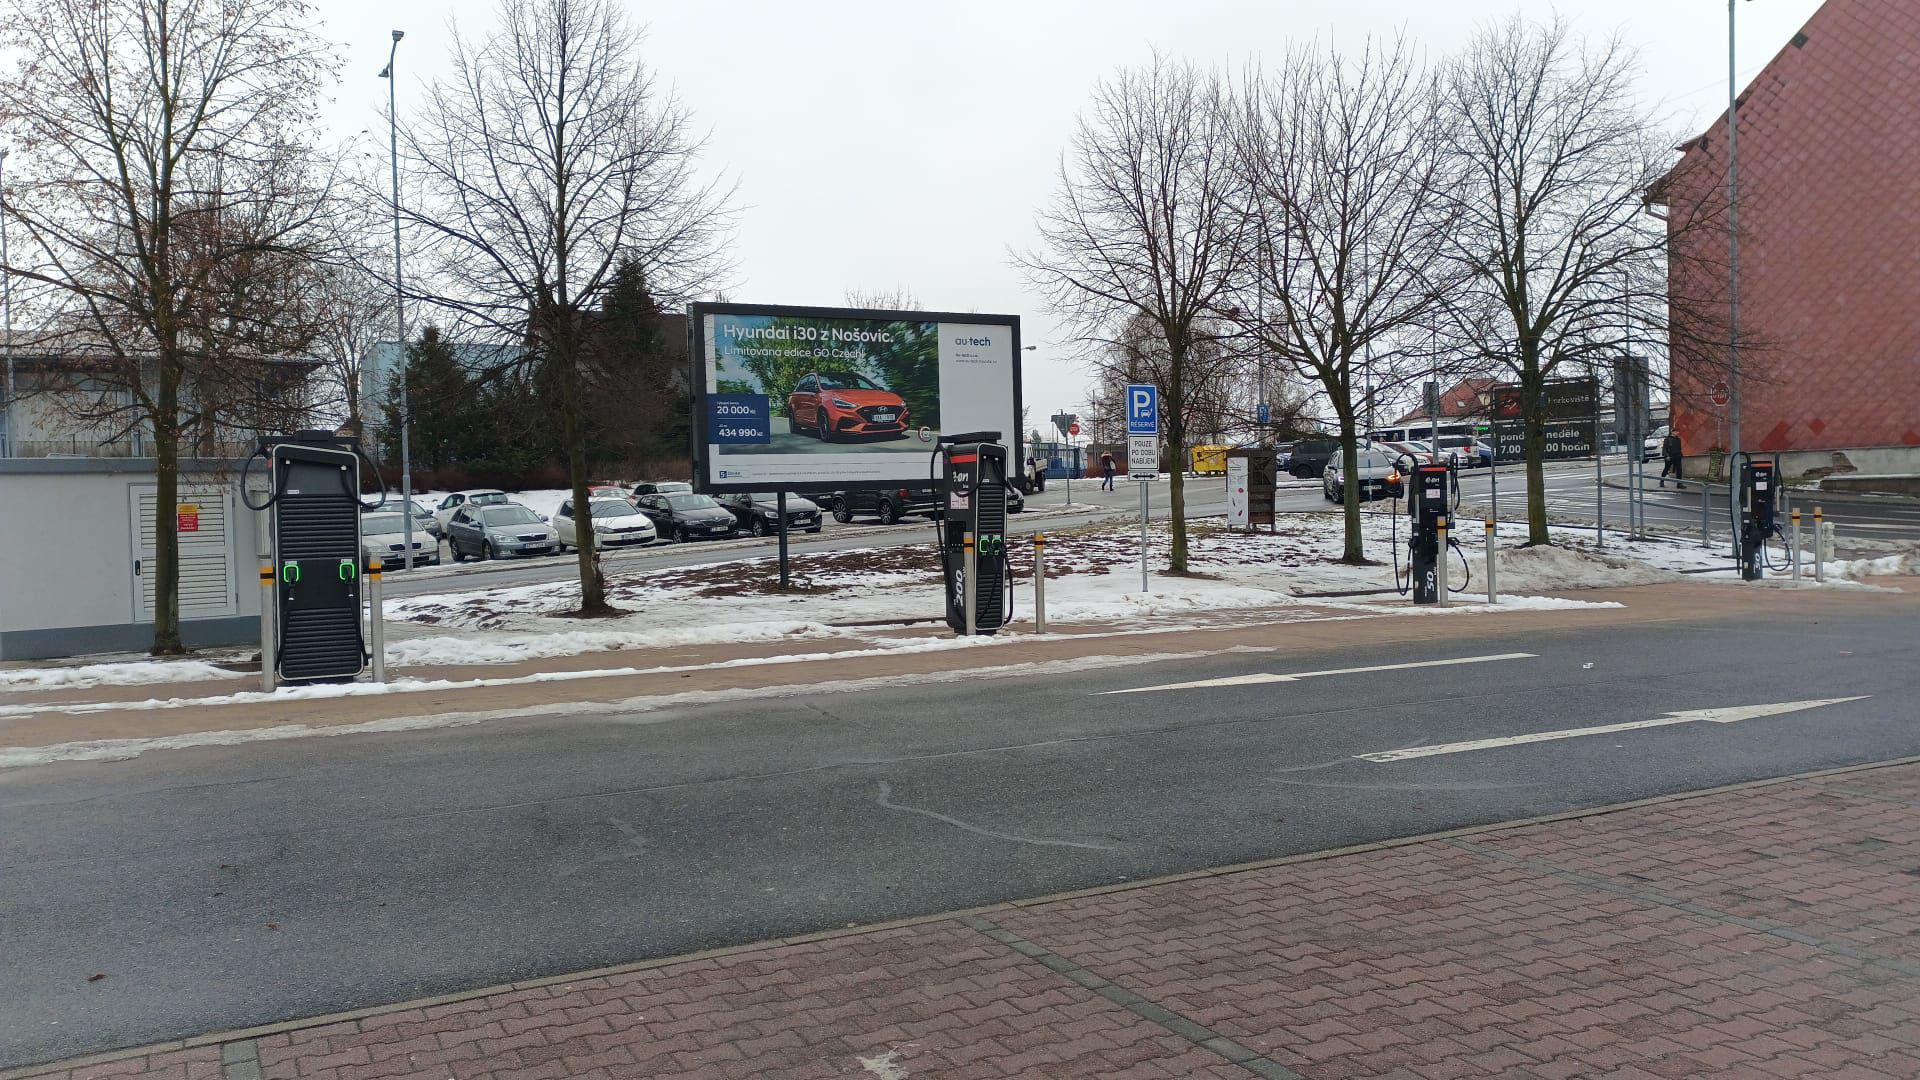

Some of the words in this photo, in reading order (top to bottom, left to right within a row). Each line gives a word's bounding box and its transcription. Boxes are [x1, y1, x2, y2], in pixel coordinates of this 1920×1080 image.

[723, 324, 790, 342] Hyundai
[793, 326, 817, 340] i30
[820, 330, 829, 341] z
[832, 328, 894, 343] Nošovic.
[784, 347, 811, 358] edice
[813, 348, 830, 358] GO
[716, 406, 729, 414] 20
[730, 406, 750, 414] 000
[1133, 391, 1151, 418] P
[718, 429, 737, 437] 434
[738, 429, 757, 437] 990
[1546, 429, 1580, 439] neděle
[1135, 440, 1153, 448] POUZE
[1500, 445, 1521, 454] 7.00
[1561, 442, 1590, 452] hodin
[1426, 570, 1435, 592] 50
[955, 569, 964, 607] 200
